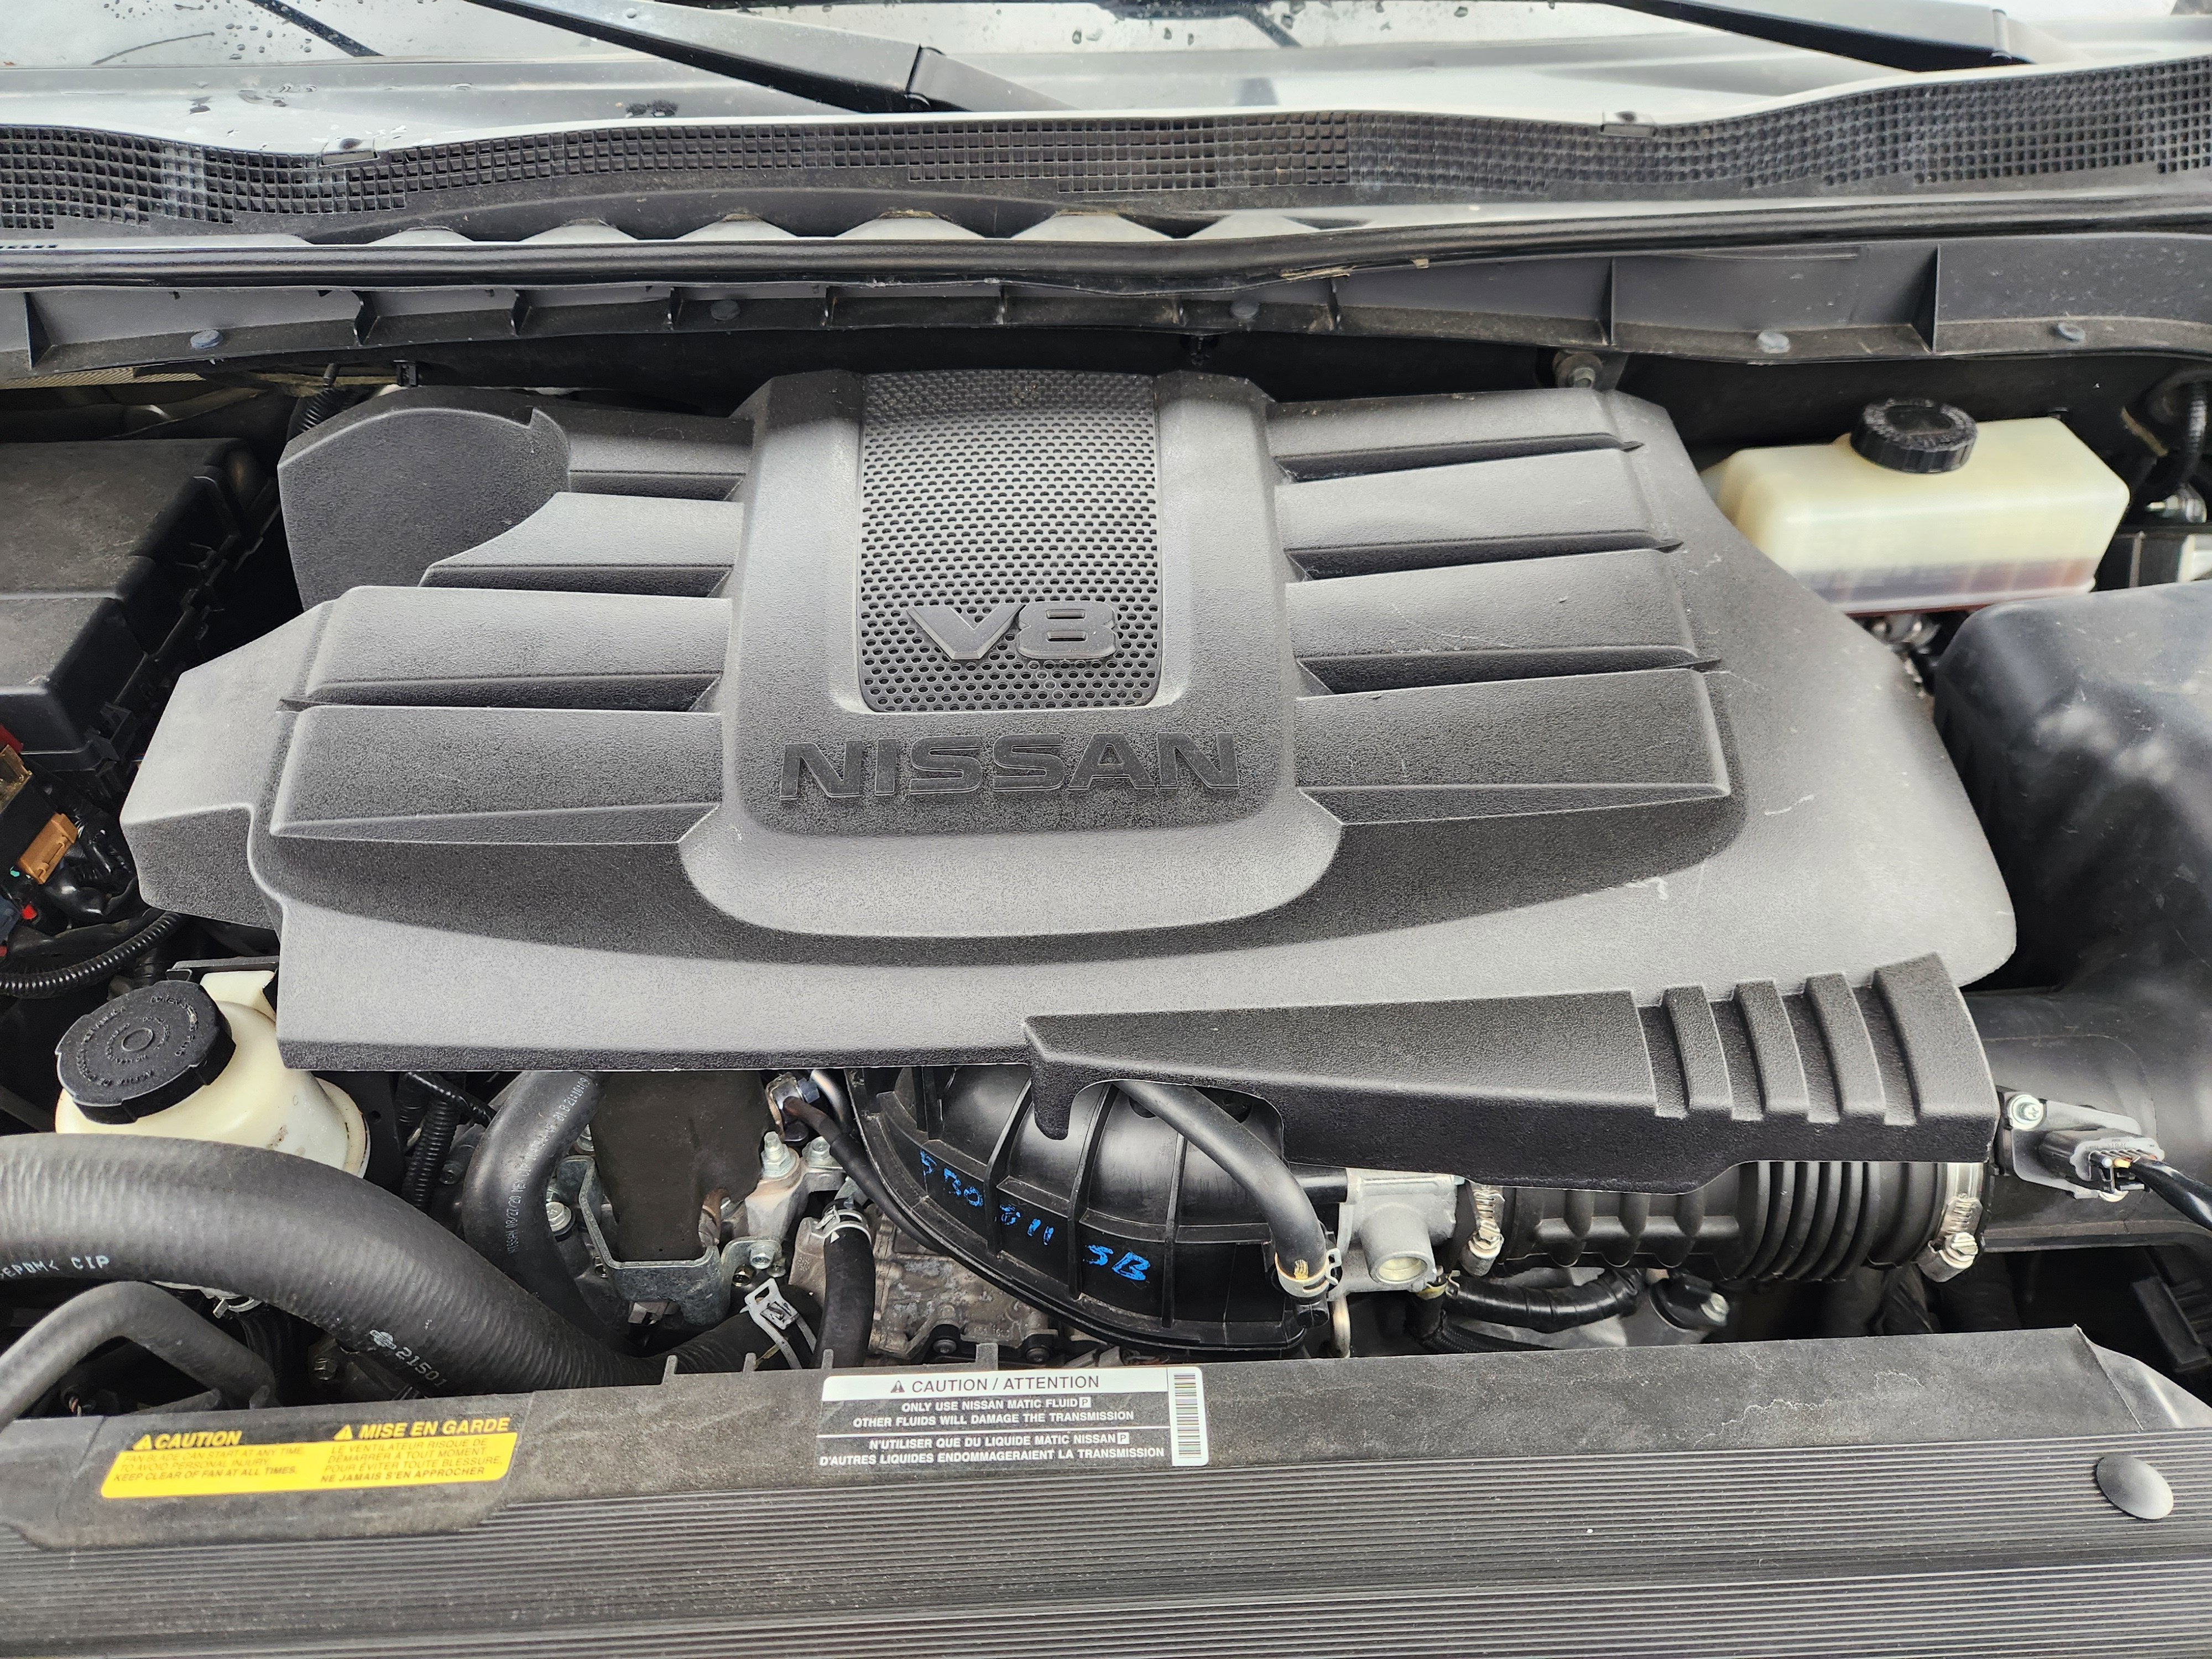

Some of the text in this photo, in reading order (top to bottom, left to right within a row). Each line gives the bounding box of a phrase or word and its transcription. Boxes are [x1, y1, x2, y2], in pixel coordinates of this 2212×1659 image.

[907, 599, 1119, 660] V8
[780, 731, 1239, 800] NISSAN
[71, 1255, 109, 1269] CIP
[395, 1347, 447, 1387] 21501
[912, 1379, 987, 1392] CAUTION
[1003, 1376, 1099, 1390] ATTENTION
[901, 1402, 932, 1412] ONLY
[935, 1401, 958, 1411] USE
[962, 1400, 1004, 1410] NISSAN
[1008, 1399, 1042, 1408] MATIC
[1046, 1398, 1078, 1408] FLUID
[853, 1411, 1134, 1428] OTHER FLUIDS WILL DAMAGE THE TRANSMISSION
[359, 1417, 510, 1439] MISE EN GARDE
[154, 1430, 242, 1449] CAUTION
[332, 1438, 488, 1454] LE VENTILATEUR RISQUE DE
[869, 1439, 932, 1449] N'UTILISER
[936, 1438, 961, 1448] QUE
[964, 1437, 982, 1447] DU
[985, 1435, 1030, 1446] LIQUIDE
[1035, 1434, 1070, 1445] MATIC
[1073, 1433, 1116, 1444] NISSAN
[183, 1452, 205, 1460] CAN
[207, 1449, 239, 1459] START
[406, 1450, 434, 1459] TOUT
[819, 1448, 1164, 1466] D'AUTRES LIQUIDES ENDOMMAGERAIENT LA TRANSMISSION
[325, 1464, 355, 1473] POUR
[404, 1459, 438, 1469] TOUTE
[114, 1473, 143, 1481] KEEP
[145, 1471, 181, 1481] CLEAR
[184, 1470, 200, 1479] OF
[201, 1469, 223, 1478] FAN
[225, 1469, 239, 1477] AT
[241, 1468, 260, 1477] ALL
[321, 1474, 336, 1483] NE
[339, 1472, 382, 1482] JAMAIS
[414, 1467, 484, 1479] APPROCHER
